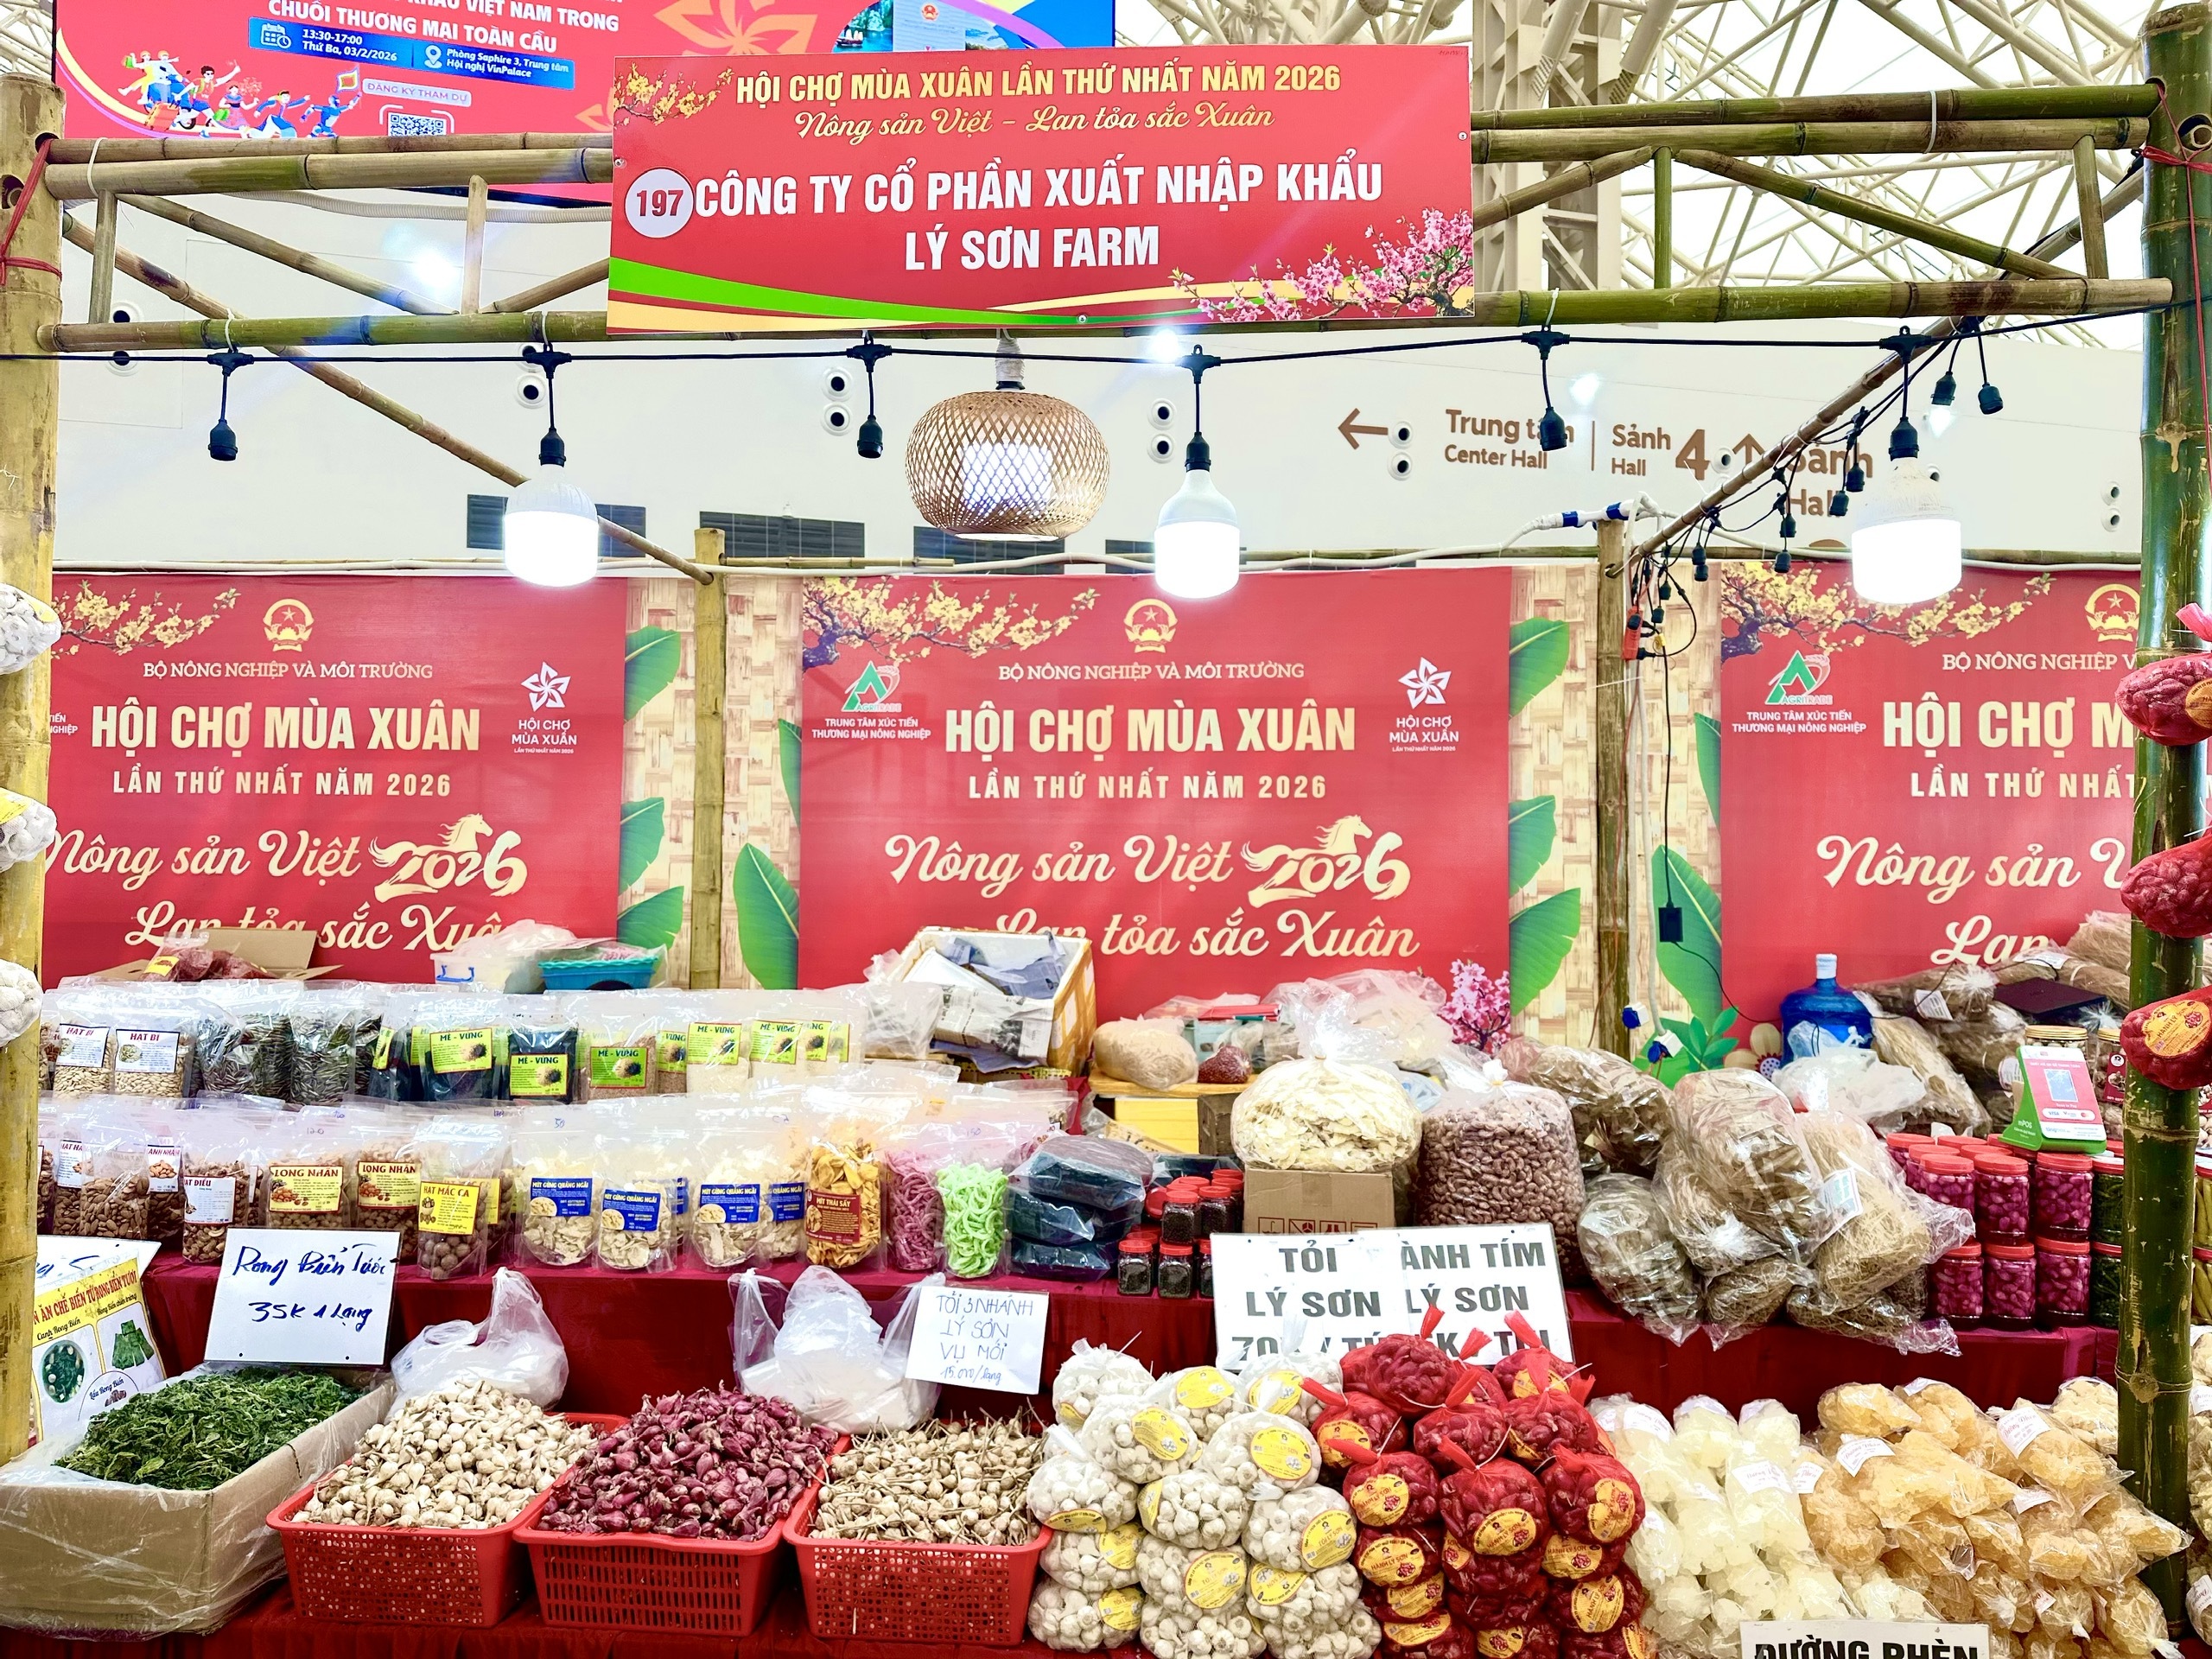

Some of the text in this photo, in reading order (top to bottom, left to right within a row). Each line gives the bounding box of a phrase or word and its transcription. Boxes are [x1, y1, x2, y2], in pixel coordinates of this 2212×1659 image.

[335, 7, 416, 34] THƯƠNG
[422, 19, 459, 41] MẠI
[463, 24, 514, 48] TOÀN
[519, 29, 557, 54] CẦU
[465, 0, 504, 16] VIỆT
[510, 0, 552, 22] NAM
[556, 8, 620, 32] TRONG
[302, 29, 363, 46] 13:30-17:00
[302, 41, 397, 62] Thứ Ba, 03/2/2026
[446, 48, 476, 61] Phòng
[477, 52, 512, 66] Saphire
[523, 59, 550, 72] Trung
[549, 61, 569, 73] tâm
[446, 59, 532, 78] Hội nghị VinPalace
[416, 89, 448, 100] THAM
[737, 56, 1341, 109] HỘI CHỢ MÙA XUÂN LẦN THỨ NHẤT NĂM 2026
[795, 100, 1275, 145] Nông sản Việt Lan tỏa sắc Xuân
[636, 148, 1382, 218] 197 CÔNG TY CỔ PHẦN XUẤT NHẬP KHẨU
[905, 223, 1159, 270] LÝ SƠN FARM
[1446, 409, 1520, 444] Trung
[1445, 443, 1548, 469] Center Hall
[1611, 457, 1646, 476] Hall
[1612, 423, 1671, 450] Sảnh
[1675, 429, 1712, 480] 4
[1786, 488, 1841, 517] Hal
[143, 659, 433, 680] BỘ NÔNG NGHIỆP VÀ MÔI TRƯỜNG
[1942, 652, 2117, 673] BỘ NÔNG NGHIỆP
[92, 696, 480, 758] HỘI CHỢ MÙA XUÂN
[518, 717, 570, 733] HỘI CHỢ
[812, 728, 931, 741] THƯƠNG MẠI NÔNG NGHIỆP
[825, 715, 918, 728] TRUNG TÂM XÚC TIẾN
[945, 698, 1357, 762] HỘI CHỢ MÙA XUÂN
[1883, 692, 1961, 757] HỘI
[1979, 696, 2075, 757] CHỢ
[512, 732, 577, 745] MÙA XUÂN
[969, 766, 1327, 799] LẦN THỨ NHẤT NĂM 2026
[43, 828, 361, 890] Nông sản Việt
[368, 828, 528, 903] 2026
[1816, 836, 1975, 905] Nông
[1985, 843, 2081, 887] sản
[1102, 906, 1421, 957] tỏa sắc Xuân
[274, 1169, 305, 1178] LONG
[363, 1164, 386, 1173] LONG
[1279, 1239, 1338, 1273] TỎI
[1401, 1237, 1547, 1271] ÀNH TÍM
[1246, 1287, 1382, 1318] LÝ SƠN
[1405, 1283, 1529, 1313] LÝ SƠN
